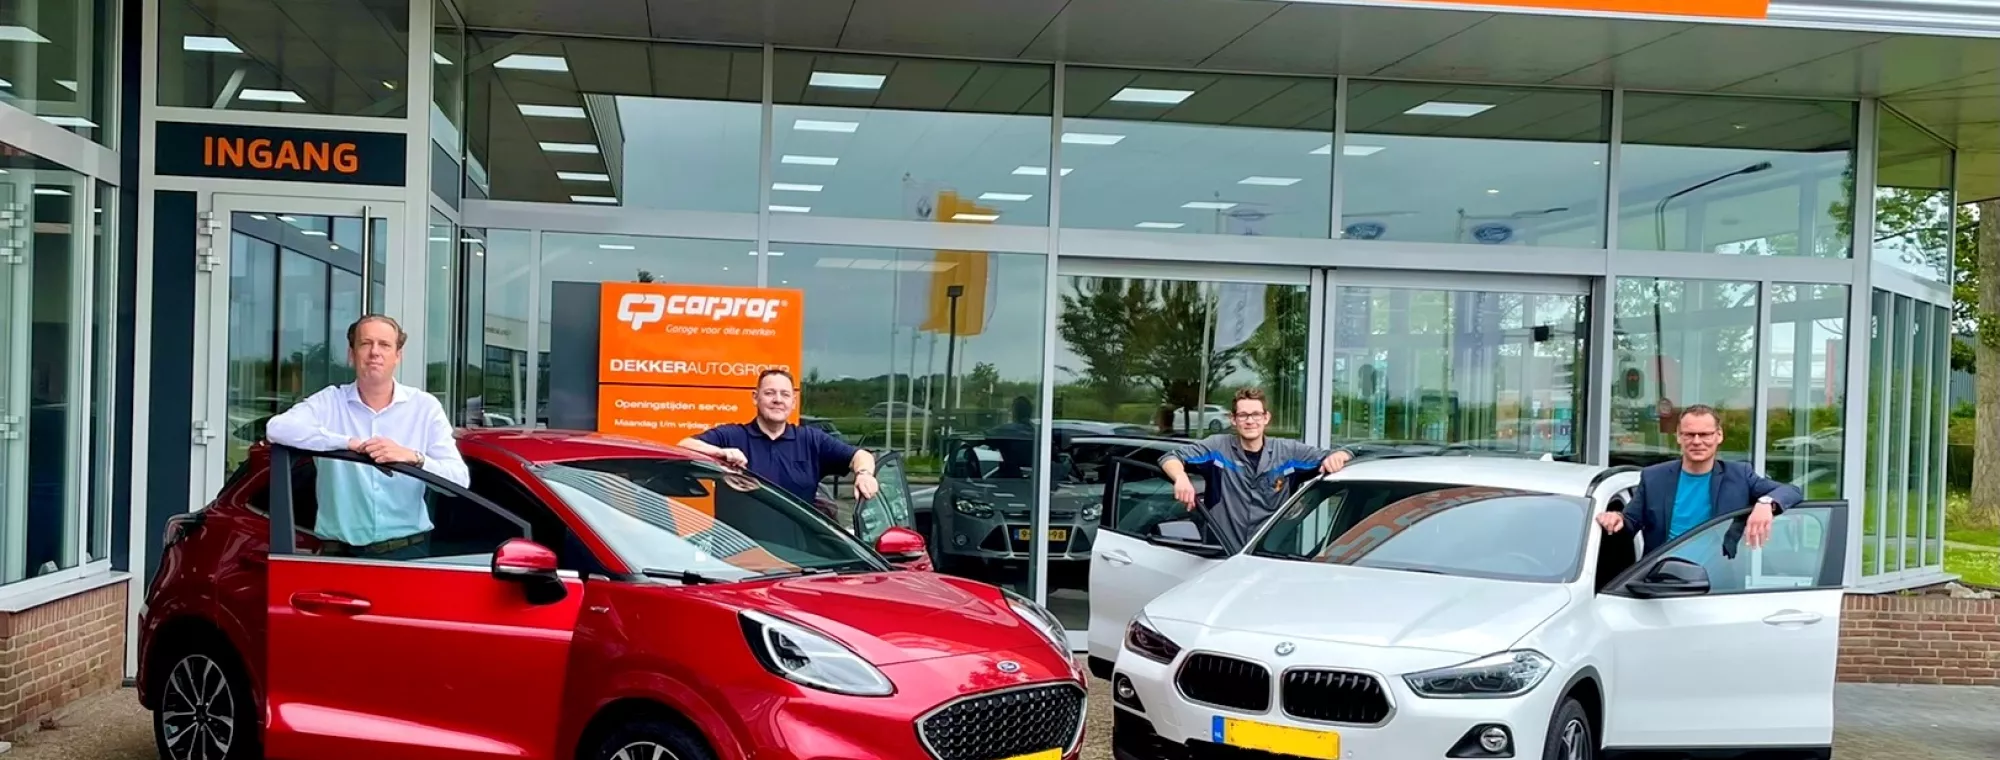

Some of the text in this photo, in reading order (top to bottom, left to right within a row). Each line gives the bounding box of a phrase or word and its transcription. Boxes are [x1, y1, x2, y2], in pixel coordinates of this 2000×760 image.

[204, 136, 358, 173] INGANG
[667, 295, 780, 323] carprof
[665, 323, 776, 337] Garage voor alle merken
[615, 399, 738, 412] Openingstijden service
[614, 418, 657, 429] Maandag
[660, 420, 676, 428] t/m
